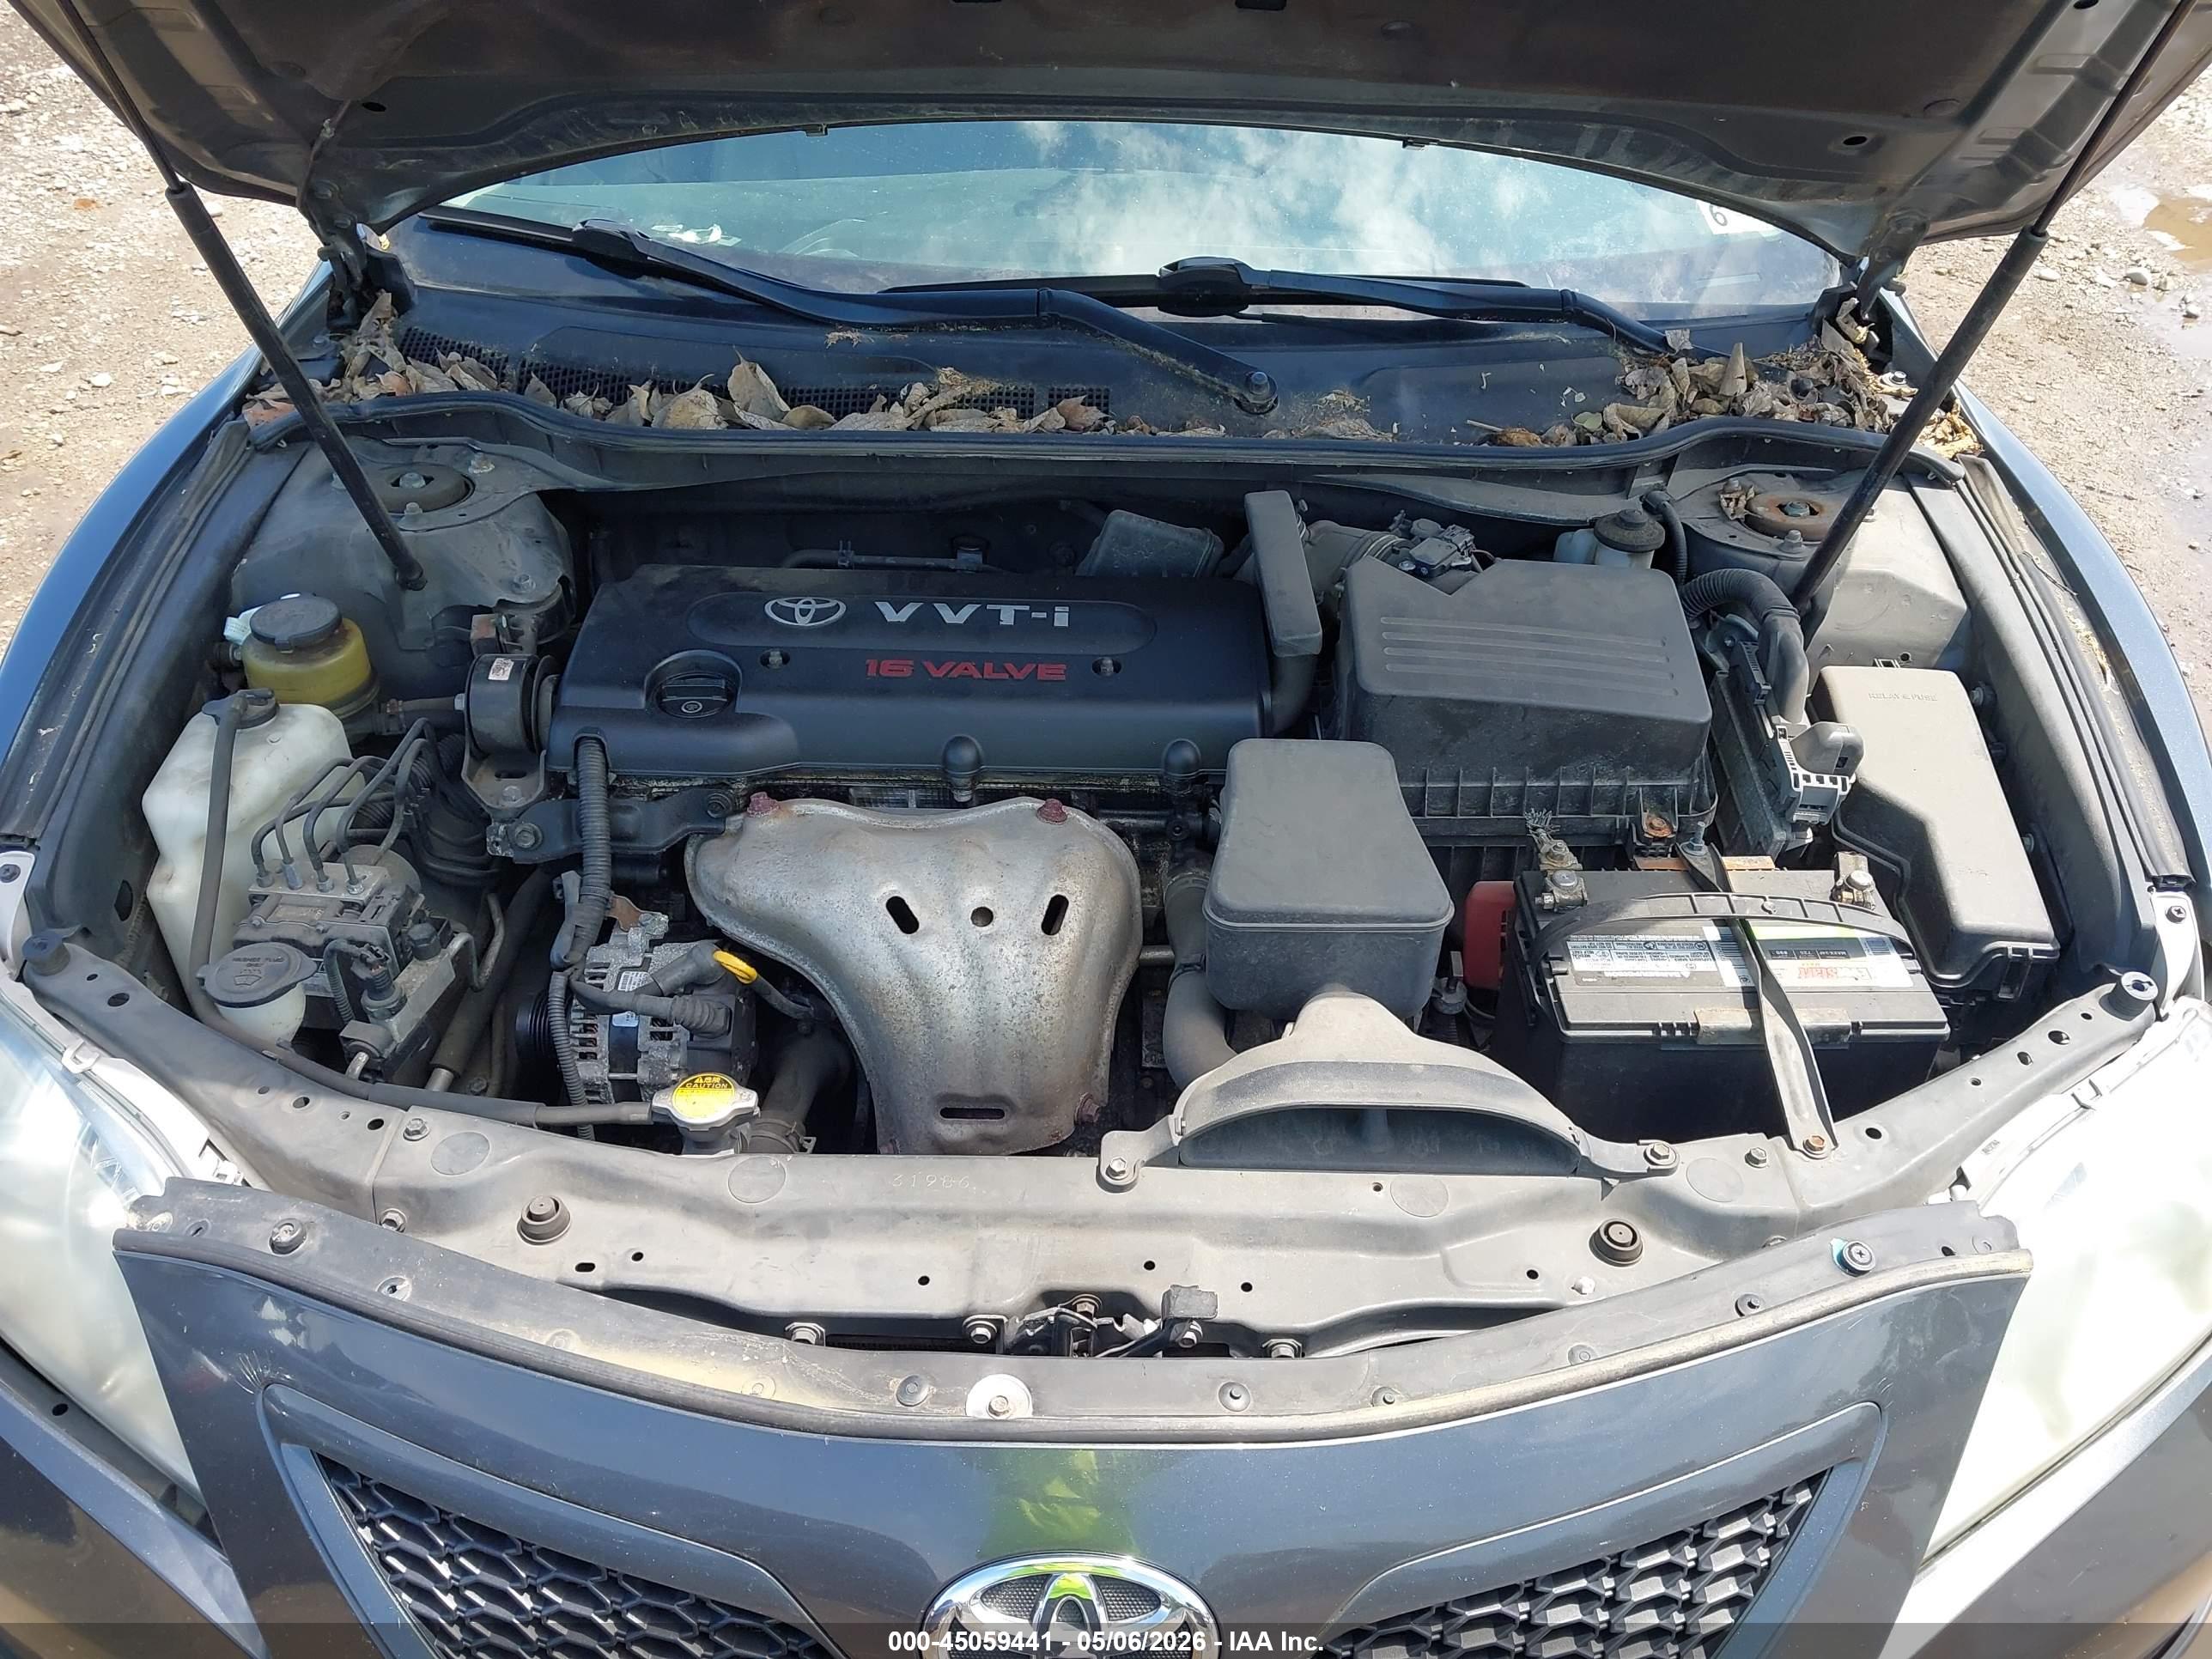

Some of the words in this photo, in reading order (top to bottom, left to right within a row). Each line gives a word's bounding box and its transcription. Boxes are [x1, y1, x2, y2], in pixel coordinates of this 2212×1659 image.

[874, 601, 1070, 628] VVT-i
[865, 659, 915, 678] 16
[921, 660, 1066, 681] VALVE
